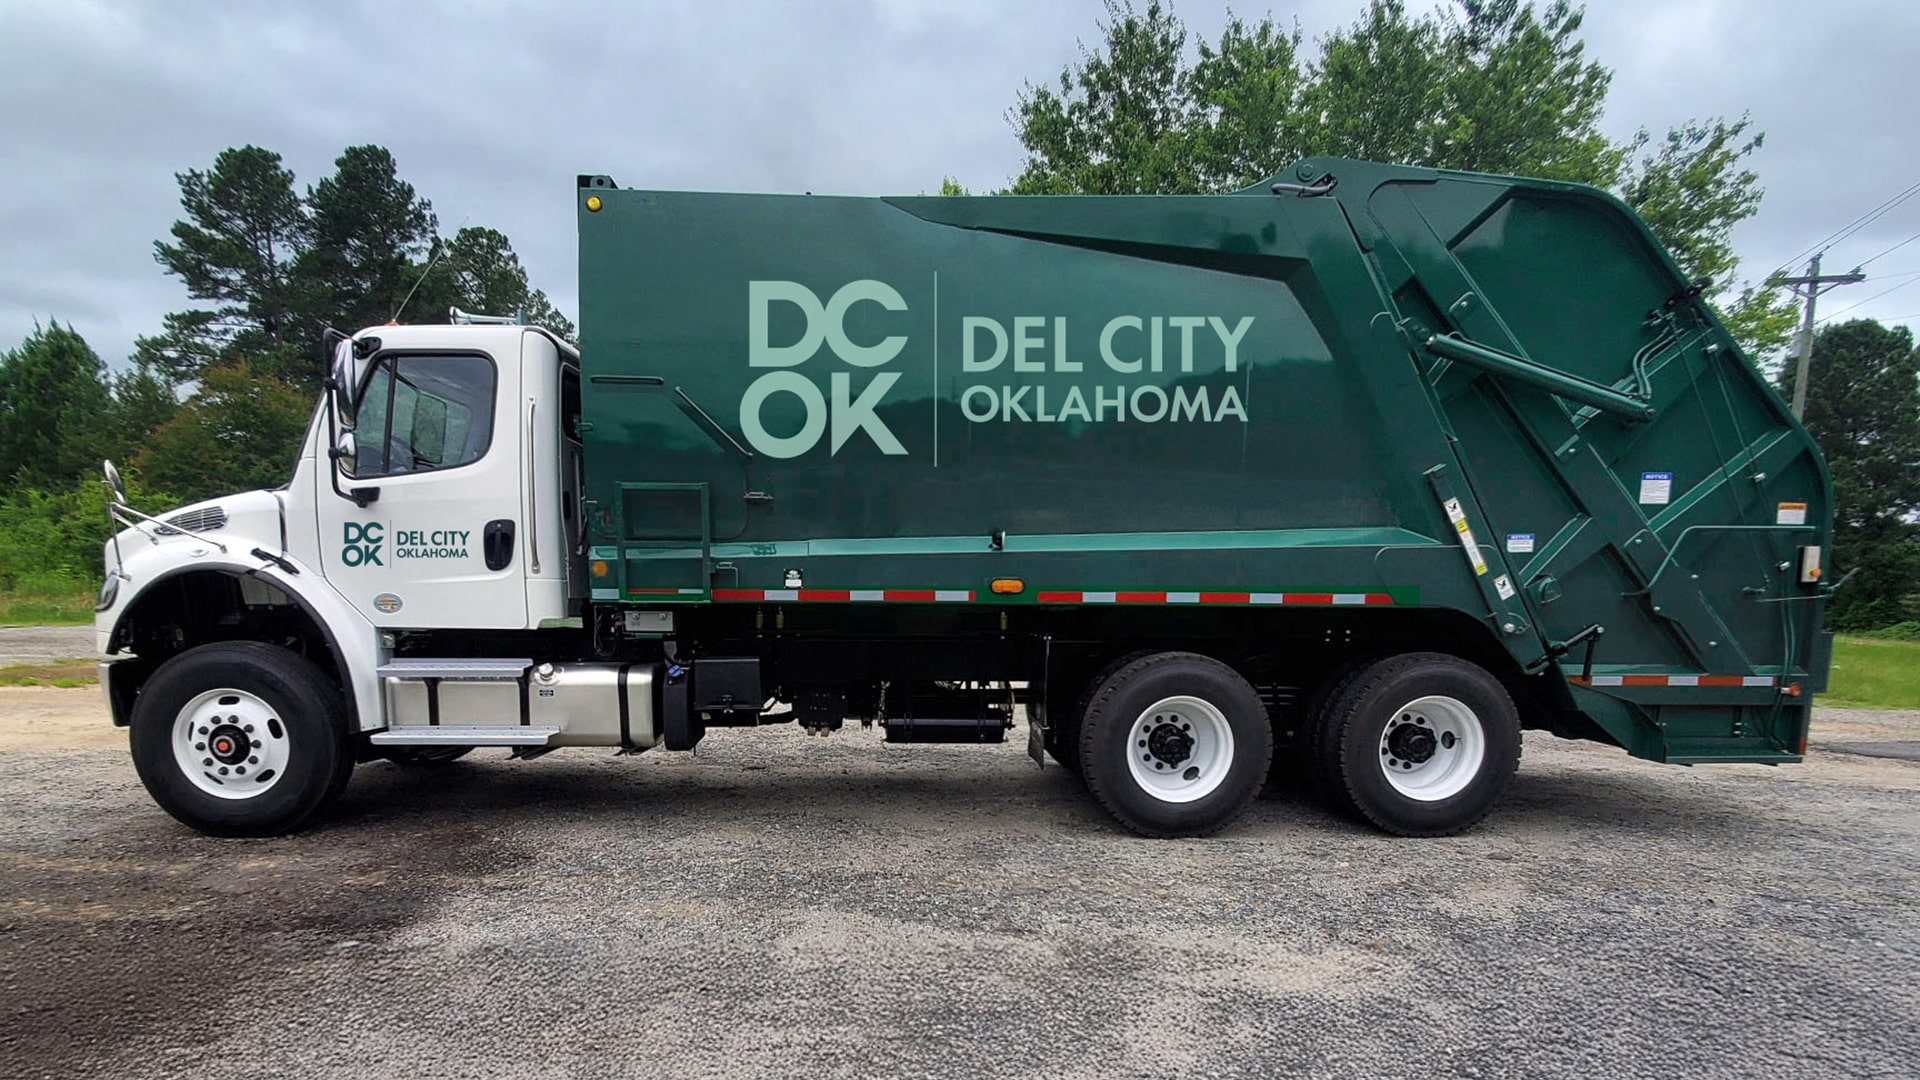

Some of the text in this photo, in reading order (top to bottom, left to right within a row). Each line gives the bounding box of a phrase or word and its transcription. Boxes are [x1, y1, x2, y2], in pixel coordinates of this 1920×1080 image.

[749, 280, 908, 367] DC
[961, 315, 1256, 373] DEL CITY
[740, 371, 908, 458] OK
[961, 385, 1249, 422] OKLAHOMA
[344, 522, 384, 544] DC
[397, 531, 470, 545] DEL CITY
[342, 545, 384, 567] OK
[396, 548, 468, 558] OKLAHOMA
